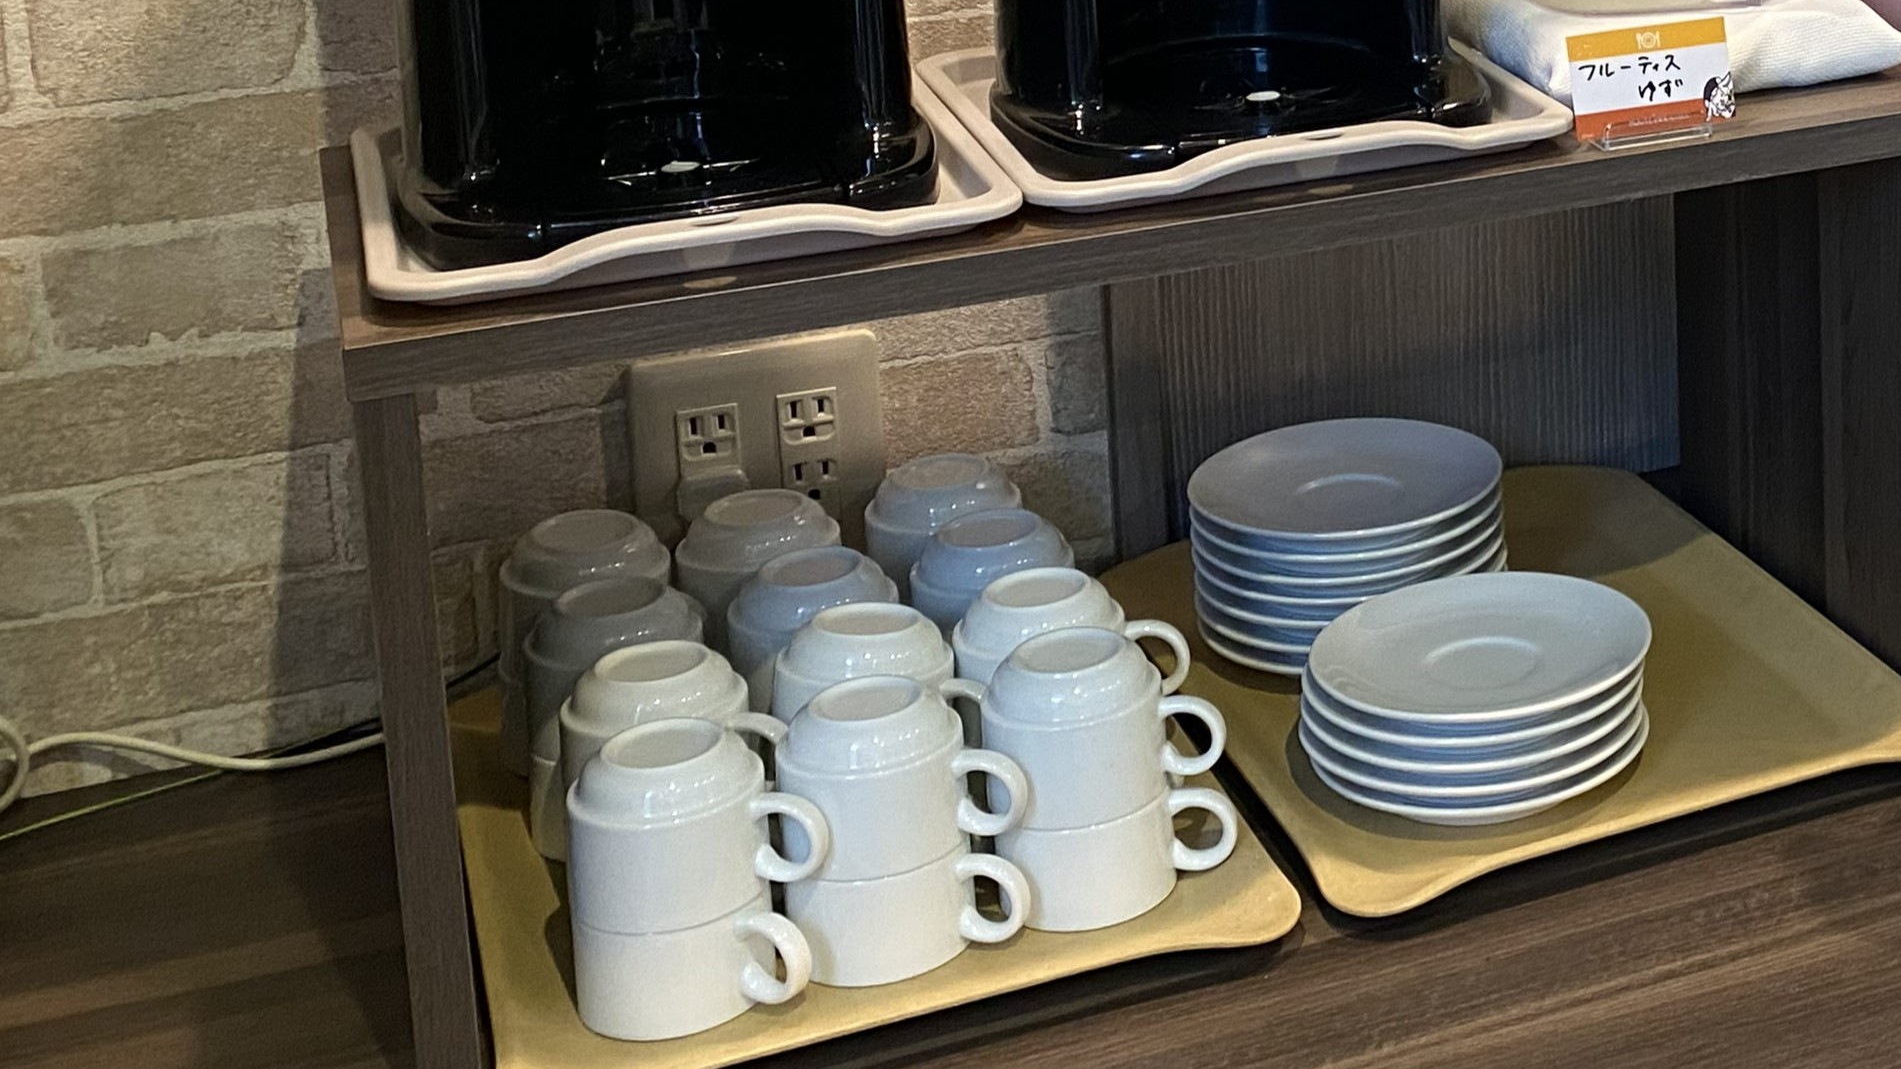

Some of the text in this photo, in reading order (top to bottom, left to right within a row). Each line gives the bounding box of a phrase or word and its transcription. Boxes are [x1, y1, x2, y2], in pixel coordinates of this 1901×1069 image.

[1577, 54, 1681, 81] フルーティス
[1638, 79, 1684, 102] ゆず
